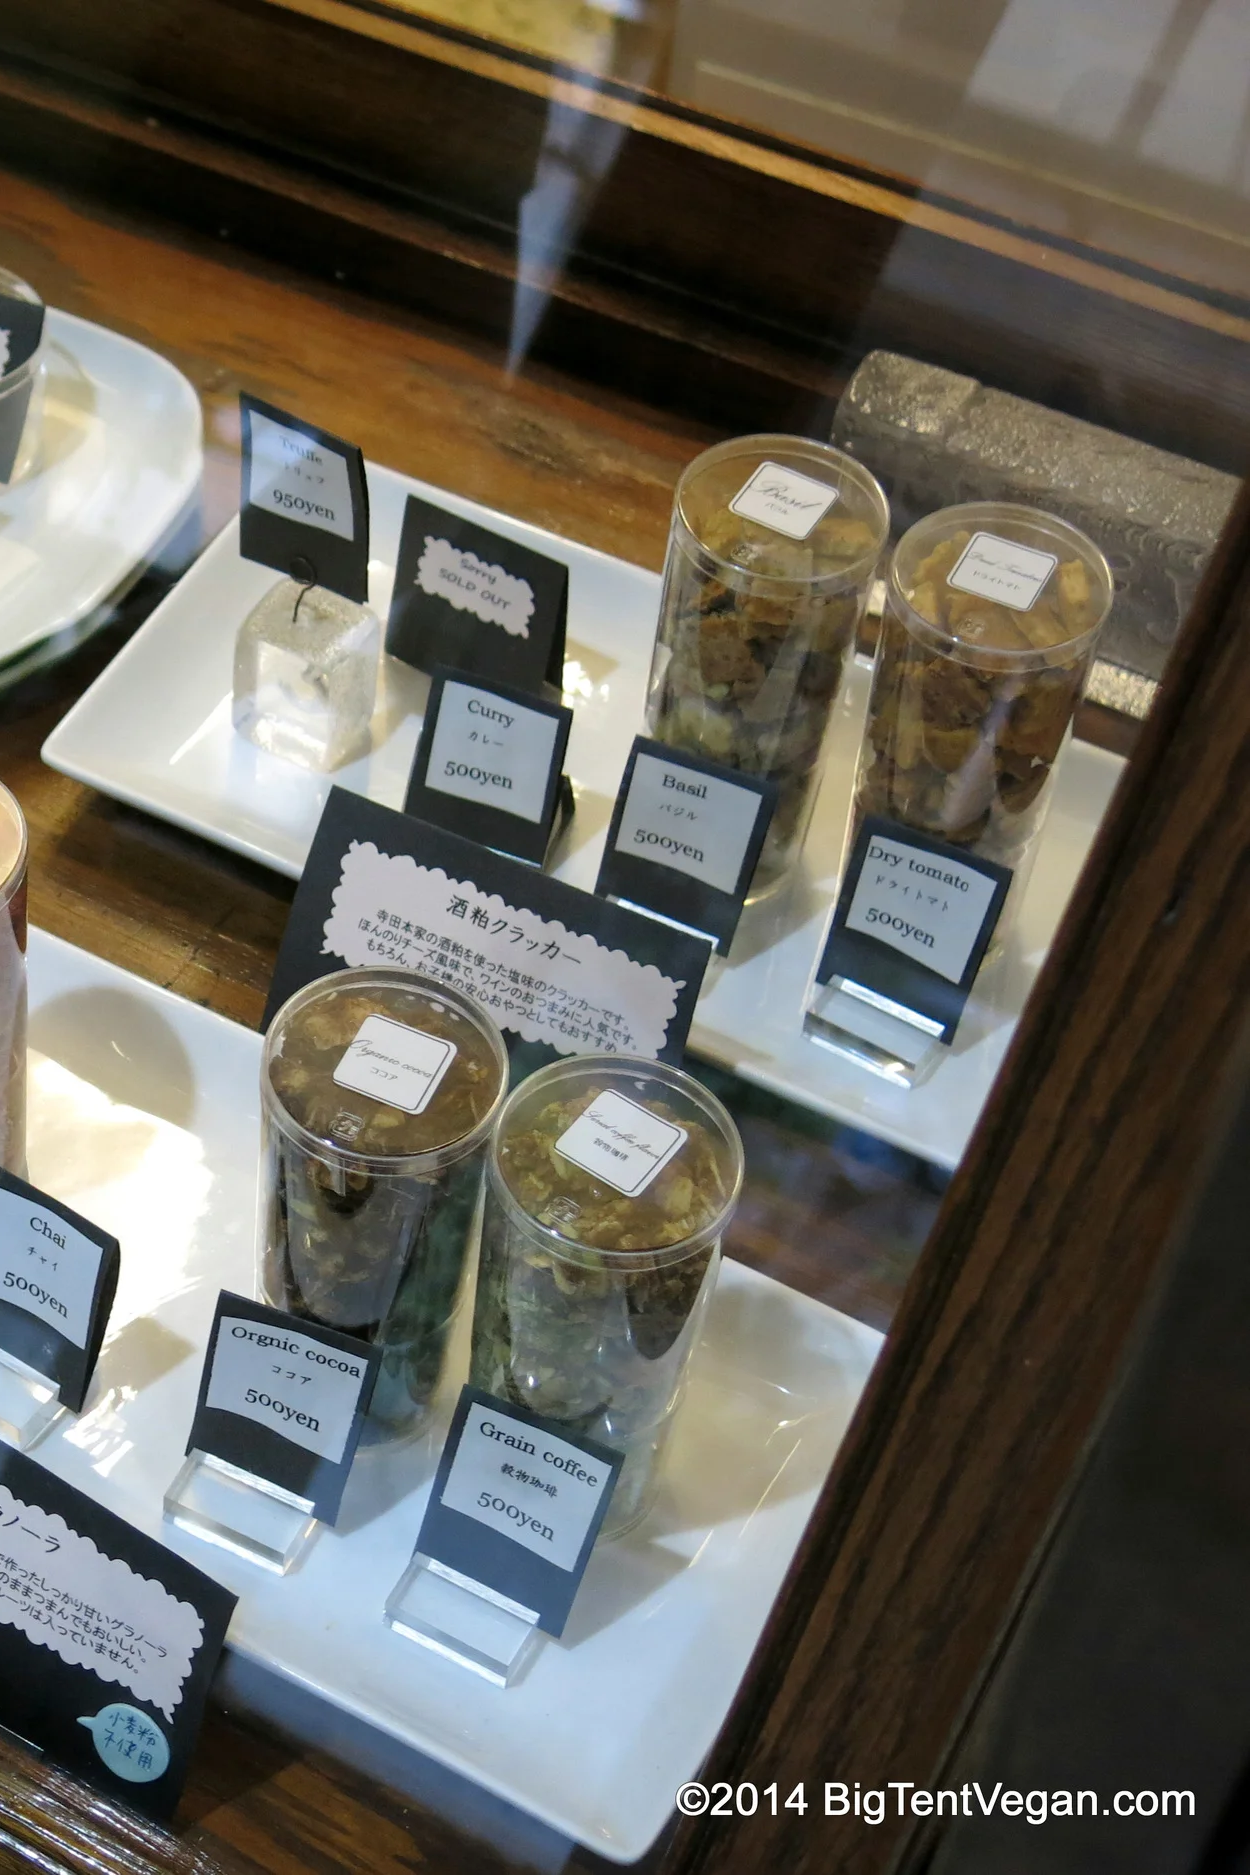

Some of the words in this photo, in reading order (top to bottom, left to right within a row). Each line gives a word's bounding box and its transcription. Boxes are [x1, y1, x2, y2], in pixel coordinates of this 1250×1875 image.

[273, 489, 336, 522] 950yen
[438, 567, 477, 592] SOLD
[480, 589, 511, 611] OUT
[460, 558, 498, 585] Sorry
[467, 698, 515, 729] Curry
[468, 730, 504, 747] カレー
[444, 760, 513, 790] 500yen
[662, 773, 708, 800] Basil
[659, 803, 699, 821] バジル
[633, 829, 705, 863] 500yen
[868, 845, 903, 867] Dry
[908, 858, 970, 892] tomato
[875, 874, 949, 912] ドライトマト
[446, 894, 582, 965] 酒粕クラッカー
[865, 907, 935, 949] 500yen
[357, 918, 637, 1051] ほんのりチーズ風味で、ワインのおつまみに人気です。
[376, 908, 630, 1031] 寺田本家の酒粕を使った塩味のクラッカーです。
[30, 1216, 67, 1250] Chai
[27, 1246, 58, 1271] チャイ
[3, 1271, 68, 1319] 500yen
[231, 1326, 300, 1355] Orgnic
[305, 1349, 361, 1379] cocoa
[272, 1364, 312, 1385] ココア
[244, 1388, 320, 1433] 500yen
[479, 1421, 535, 1456] Grain
[543, 1451, 598, 1487] coffee
[477, 1491, 554, 1542] 500yen
[108, 1711, 160, 1746] 小麦粉
[104, 1728, 153, 1770] 不使用
